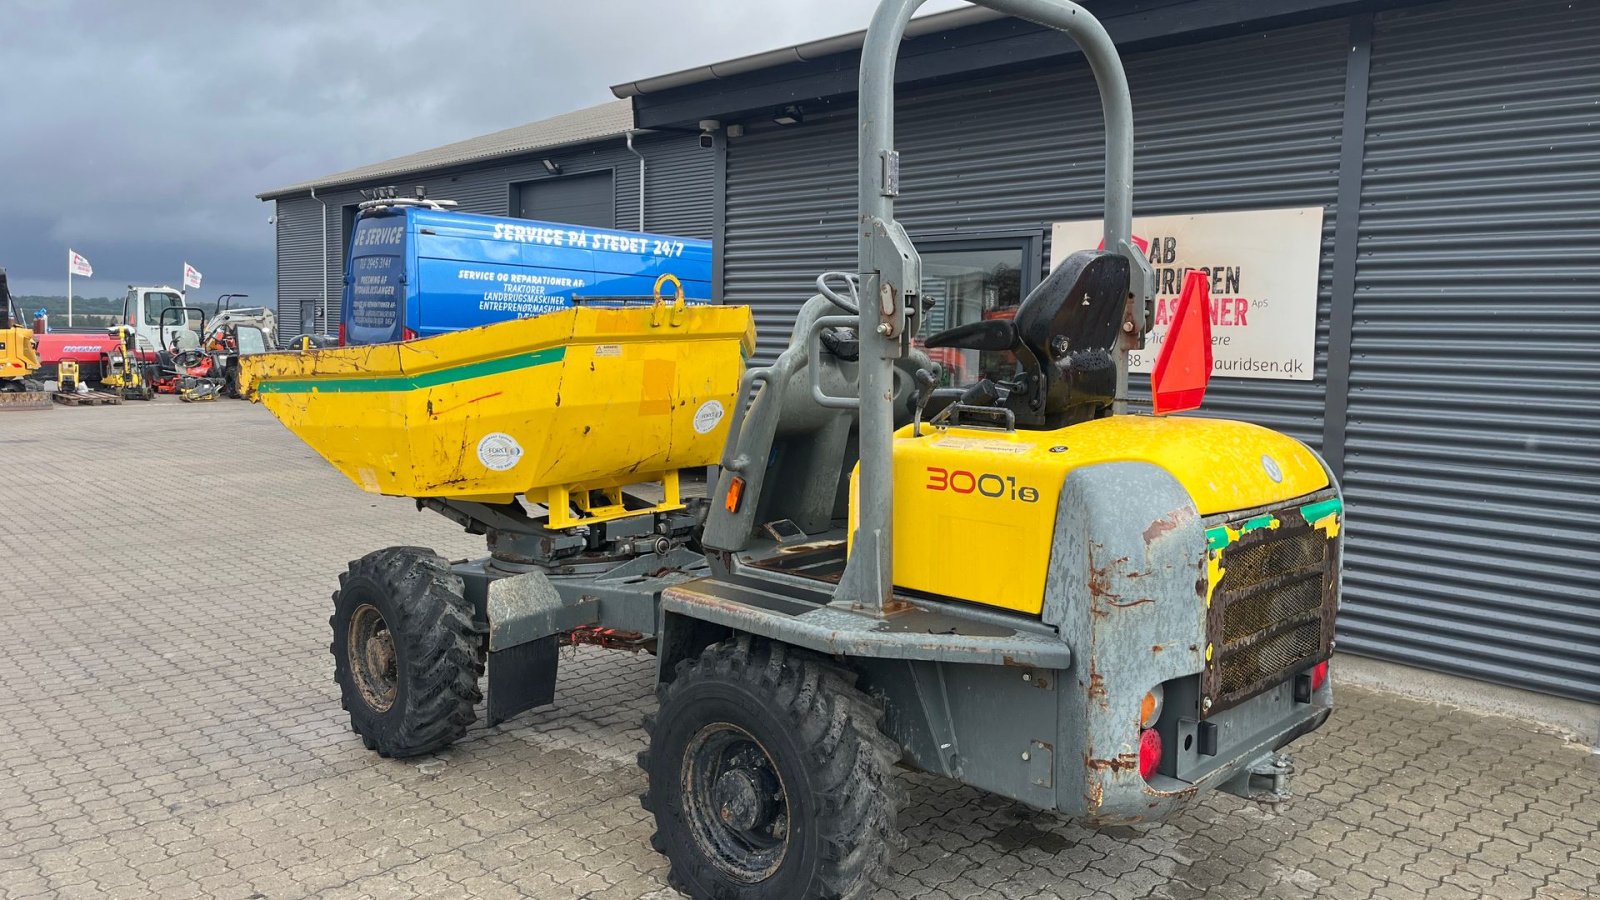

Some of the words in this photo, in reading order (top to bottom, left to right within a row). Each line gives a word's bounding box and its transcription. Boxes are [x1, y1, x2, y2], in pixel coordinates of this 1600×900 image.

[365, 226, 404, 245] SERVICE
[493, 223, 563, 246] SERVICE
[568, 230, 587, 248] PÅ
[592, 234, 649, 254] STEDET
[653, 240, 684, 258] 24/7
[1149, 237, 1176, 264] AB
[458, 270, 495, 281] SERVICE
[497, 273, 509, 282] OG
[511, 274, 572, 287] REPARATIONER
[503, 283, 545, 295] TRAKTORER
[484, 292, 565, 305] LANDBRUGSMASKINER
[1252, 299, 1268, 309] ApS
